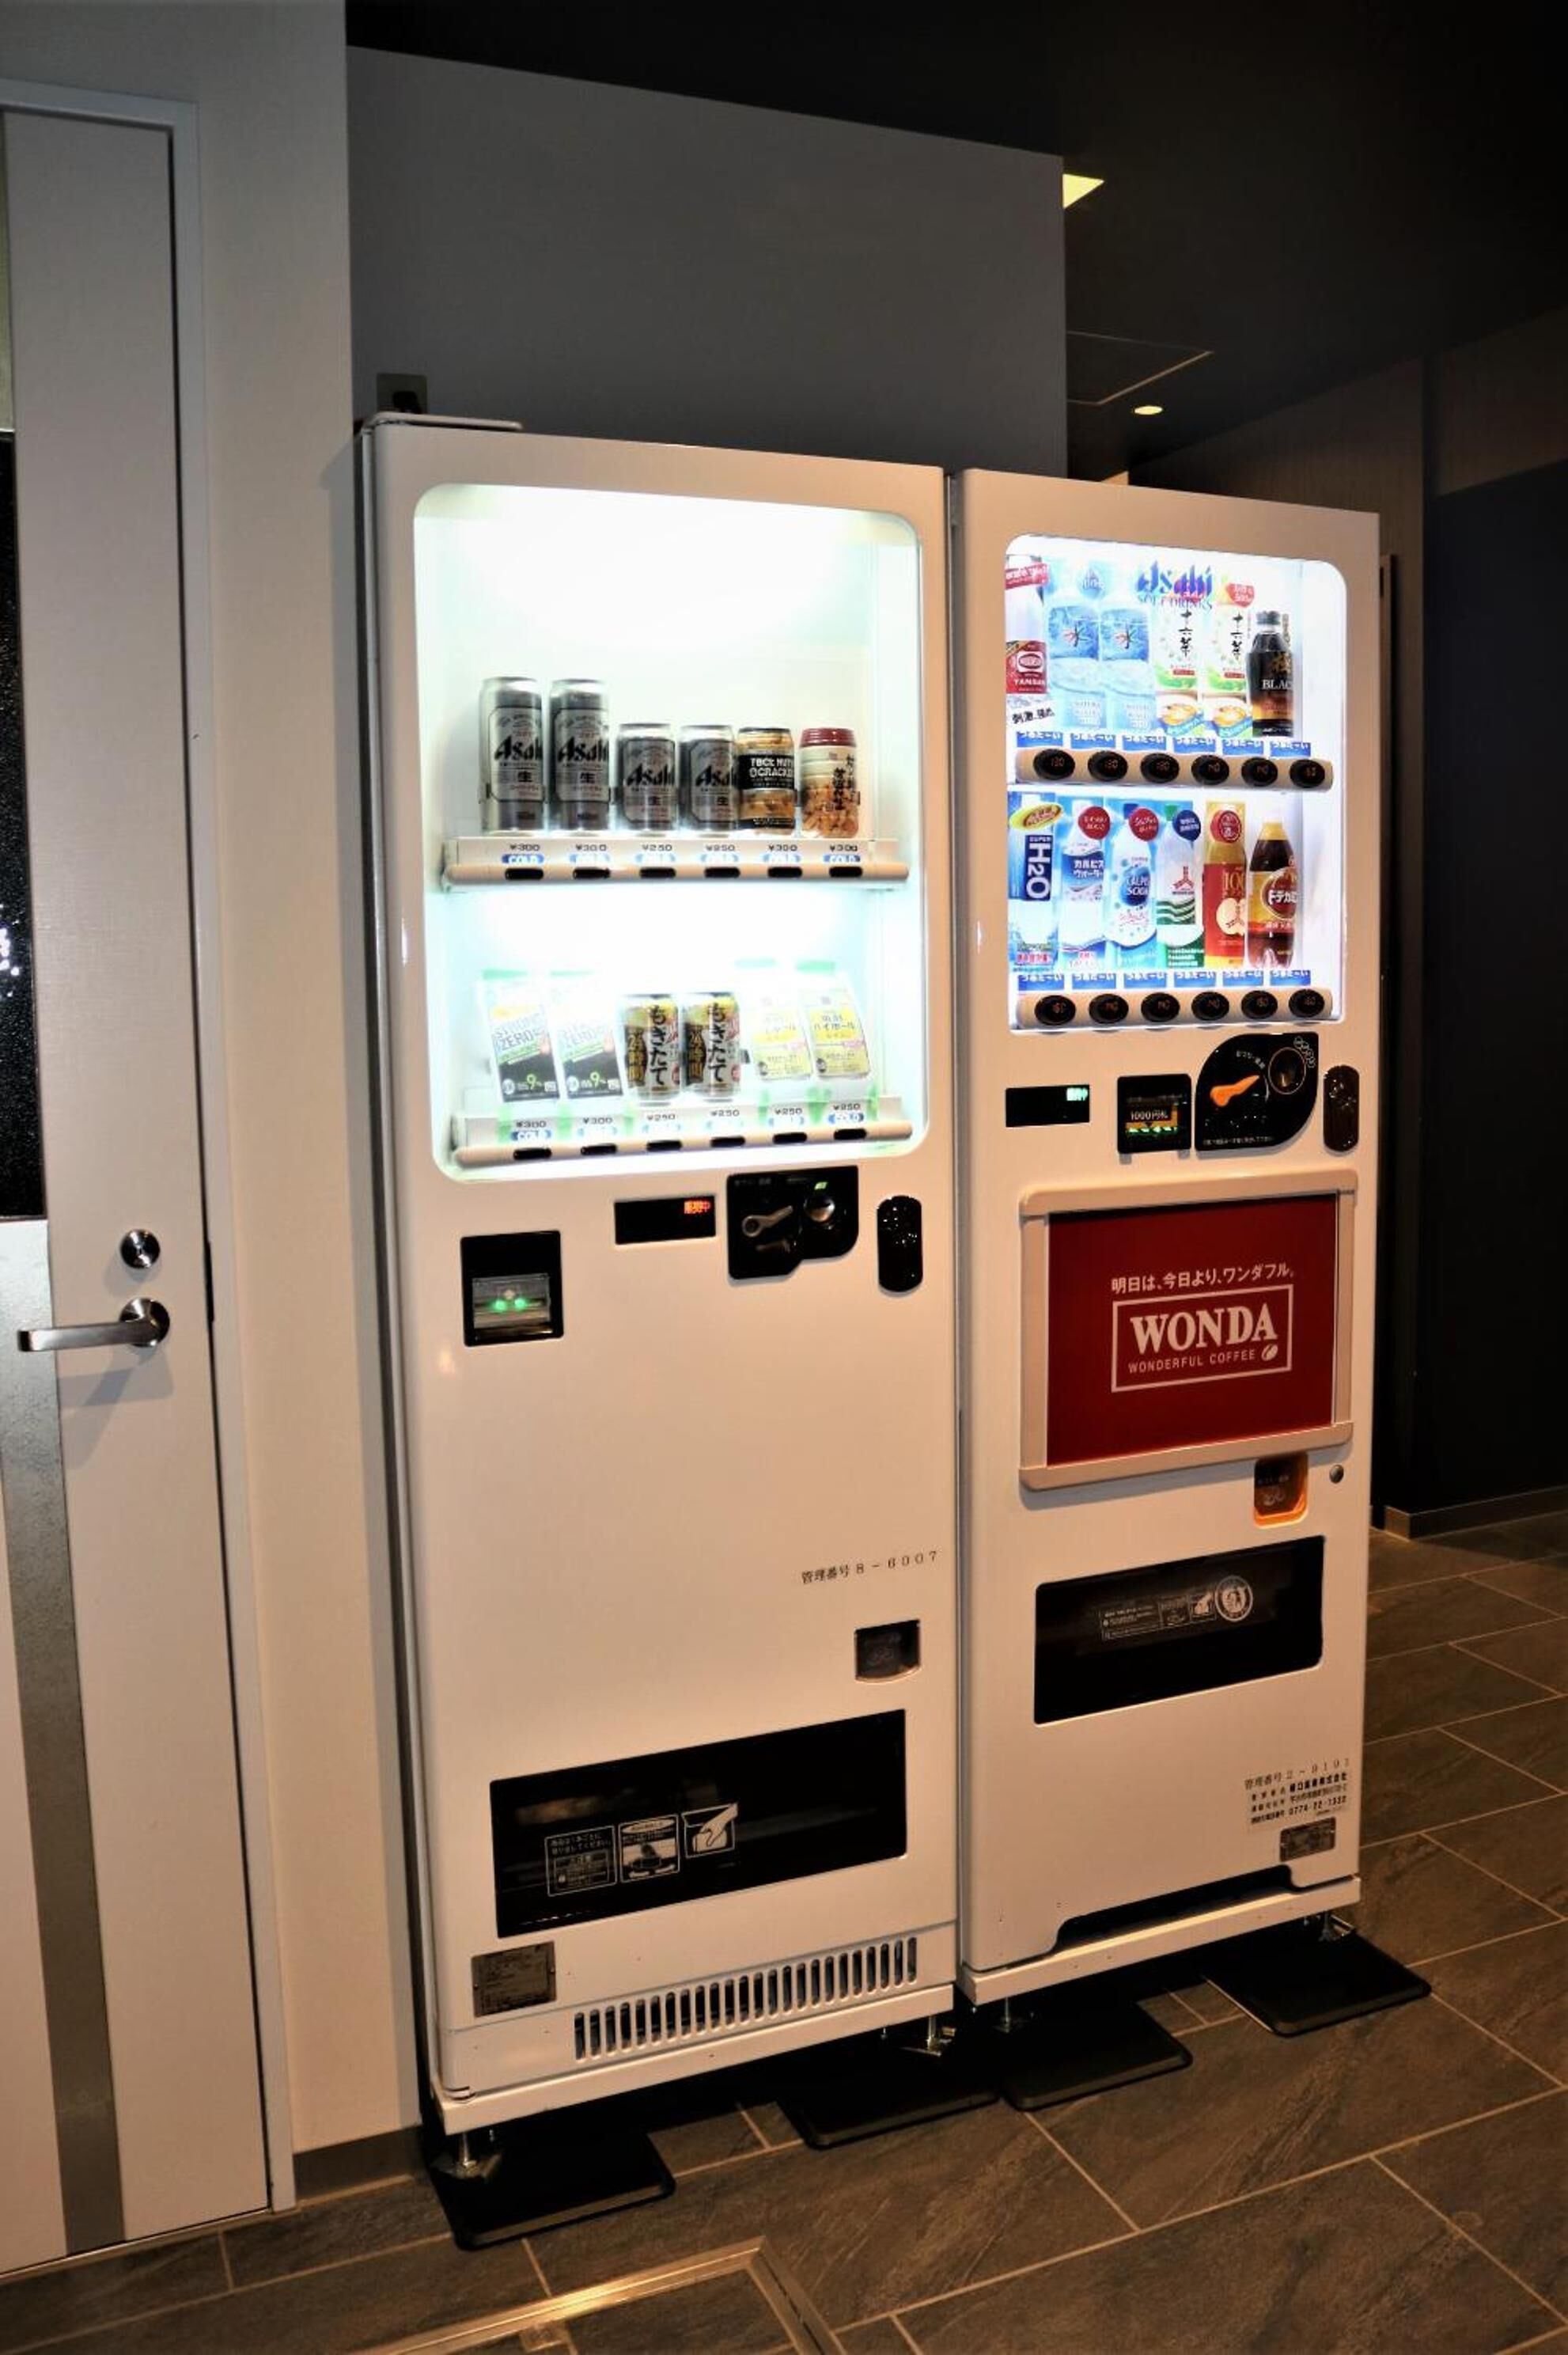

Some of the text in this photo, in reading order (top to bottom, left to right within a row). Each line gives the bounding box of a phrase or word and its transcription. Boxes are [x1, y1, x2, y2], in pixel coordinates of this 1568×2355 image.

[517, 771, 534, 783] 生
[580, 772, 596, 783] 生
[1026, 843, 1051, 899] H2O
[1111, 1262, 1294, 1295] 明日は、今日より、ワンダフル。
[1130, 1303, 1278, 1355] WONDA
[1127, 1348, 1256, 1374] WONDERFUL COFFEE
